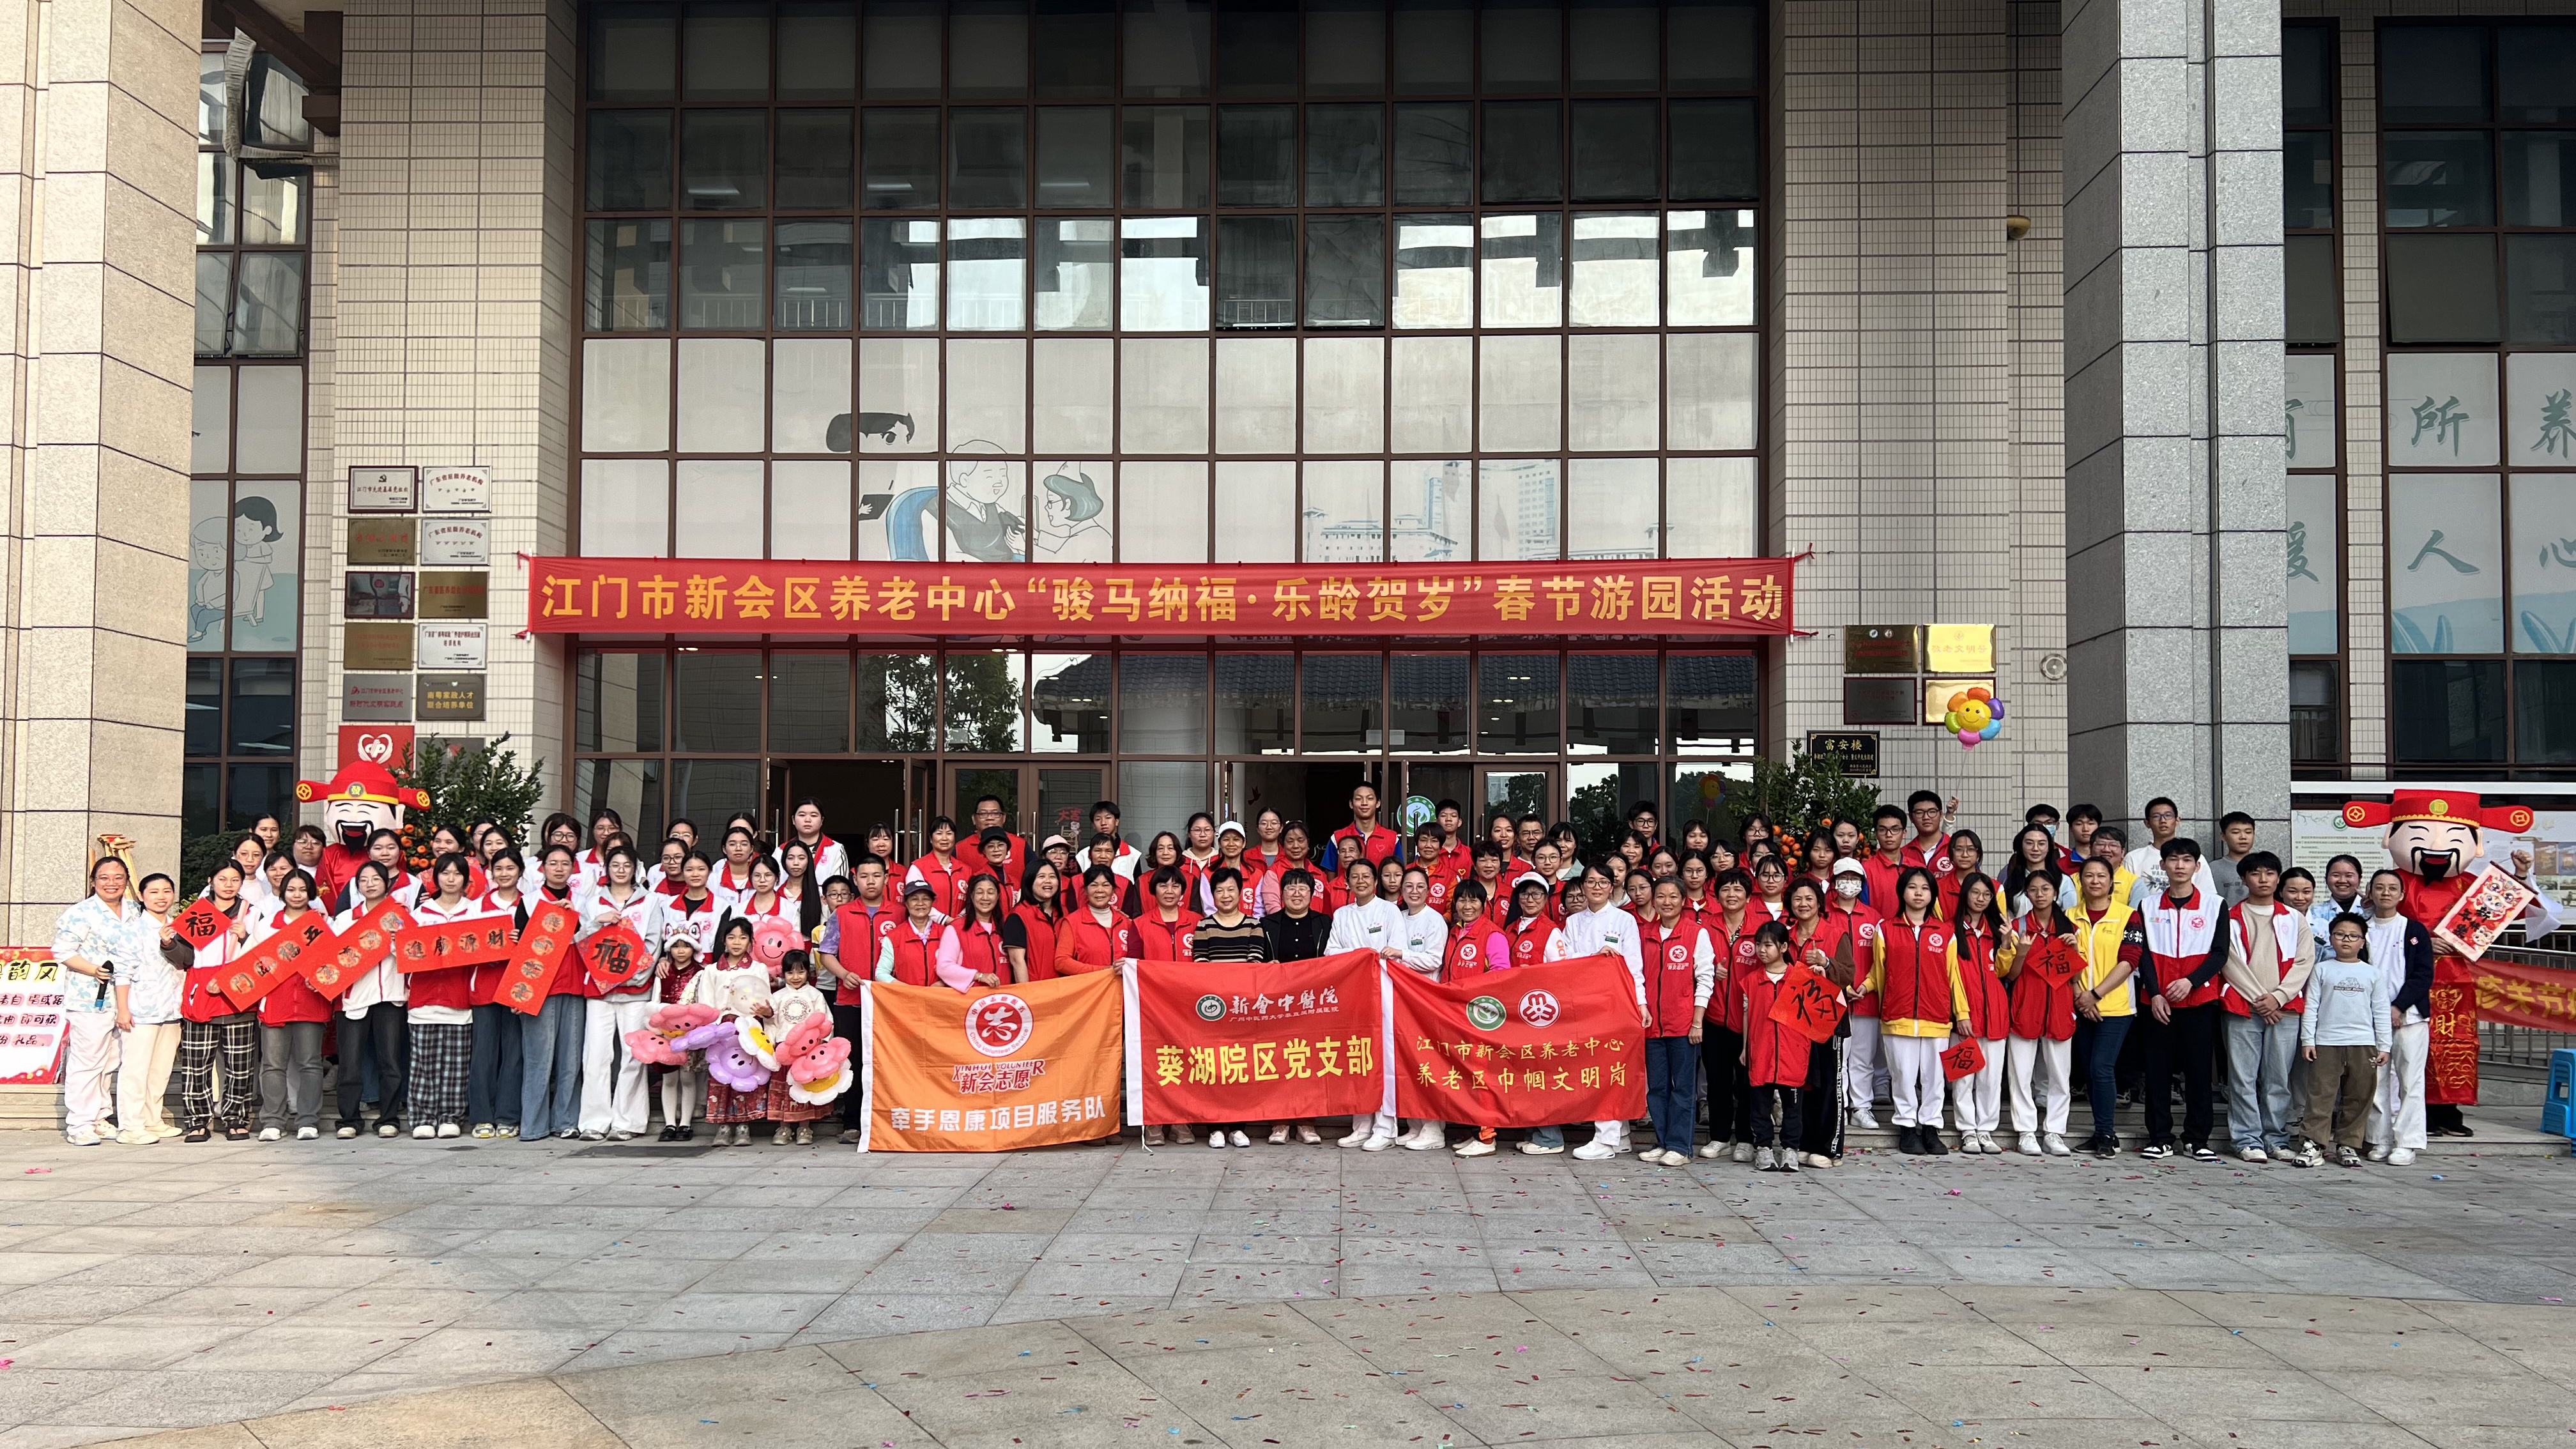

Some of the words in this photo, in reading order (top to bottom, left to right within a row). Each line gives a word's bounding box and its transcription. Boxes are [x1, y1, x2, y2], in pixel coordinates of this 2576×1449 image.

[541, 574, 1783, 623] 江门市新会区养老中心“骏马纳福·乐龄贺岁”春节游园活动
[427, 691, 474, 700] 南粤家政人才
[427, 701, 474, 710] 联合培养单位
[1825, 738, 1863, 751] 富安楼
[185, 910, 218, 937] 福
[591, 939, 634, 975] 福
[2037, 949, 2071, 977] 福
[0, 960, 59, 981] 韵风
[970, 1032, 982, 1048] China
[982, 1046, 1011, 1055] Volunteer
[1011, 1029, 1029, 1050] Service
[1416, 1035, 1625, 1061] 江门市新会区养老中心
[1155, 1034, 1374, 1087] 葵湖院区党支部
[1947, 1045, 1975, 1071] 福
[953, 1065, 992, 1080] XINHUI
[960, 1068, 1031, 1093] 新会志愿
[1416, 1061, 1627, 1093] 养老区巾帼文明岗
[890, 1095, 1107, 1131] 牵手恩康项目服务队
